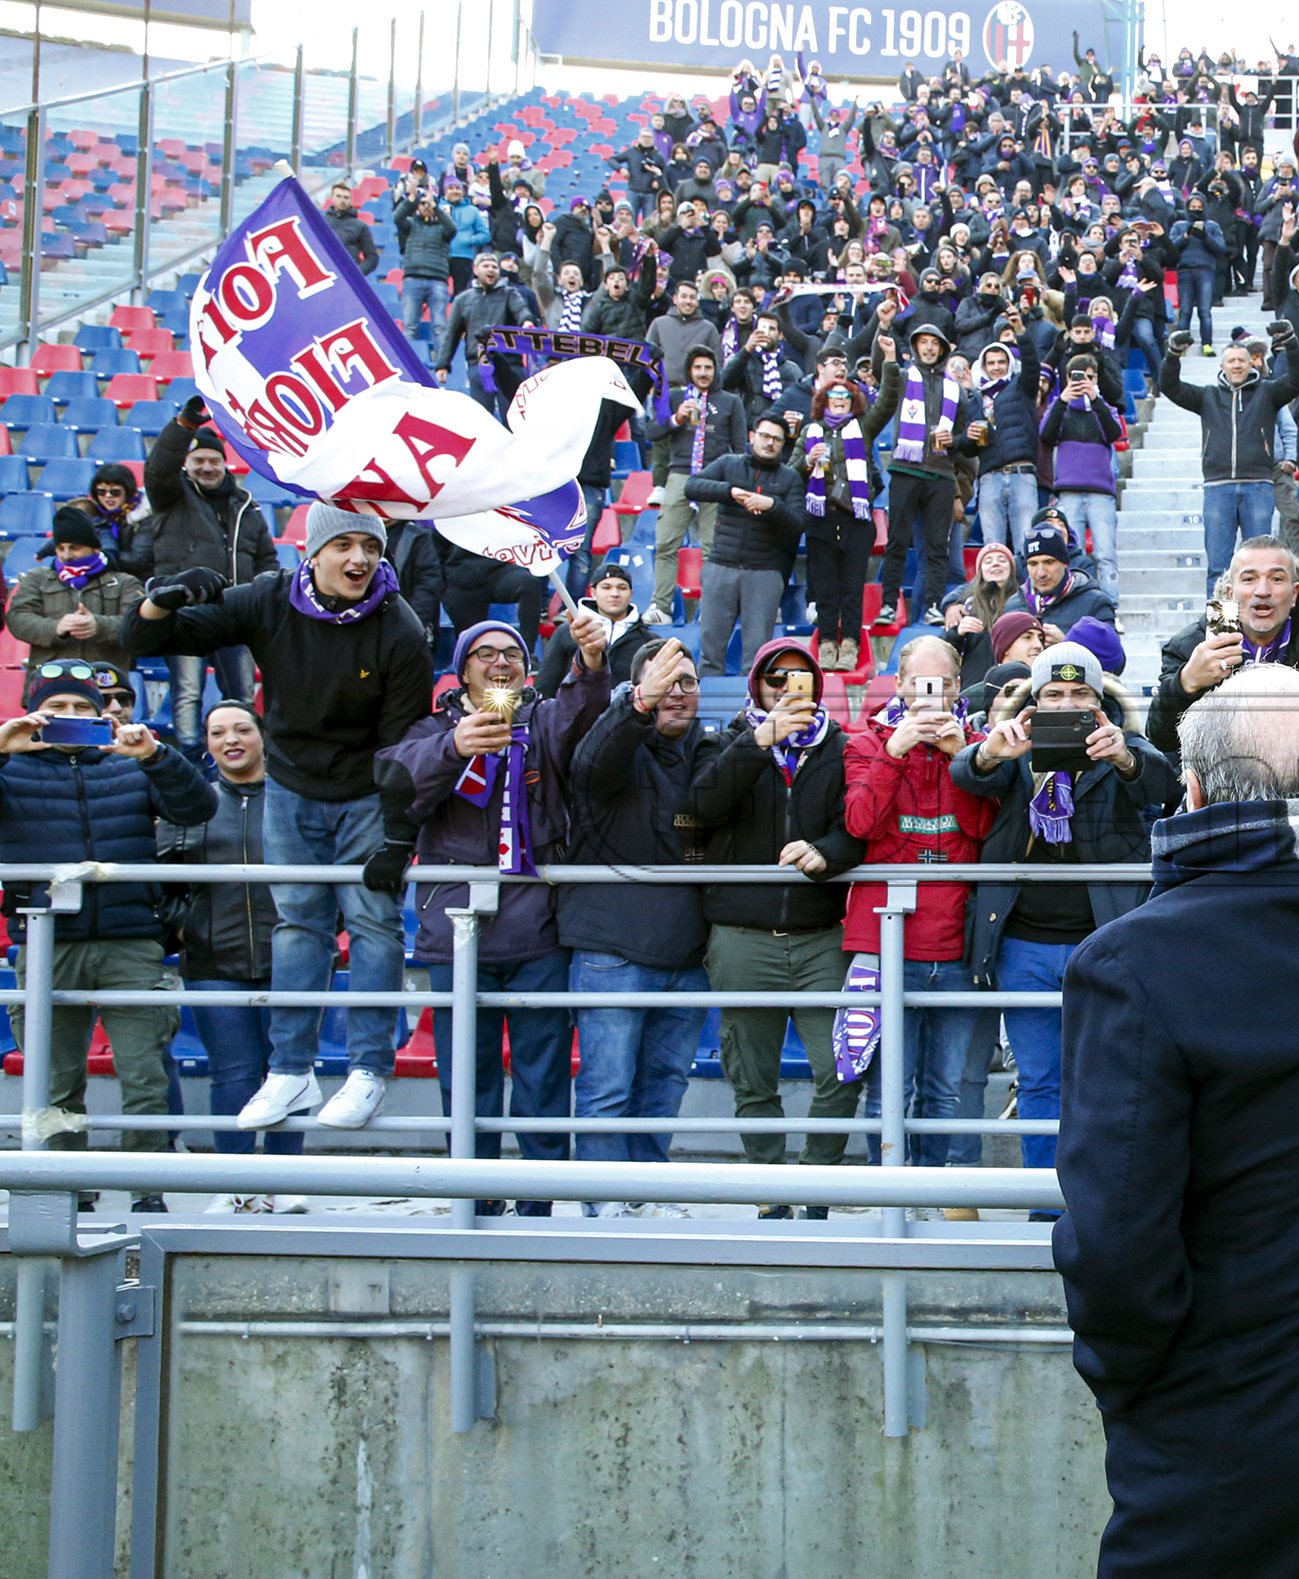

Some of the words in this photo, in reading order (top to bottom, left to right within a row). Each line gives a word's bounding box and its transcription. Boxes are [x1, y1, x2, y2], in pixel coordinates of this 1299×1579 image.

[649, 0, 818, 53] BOLOGNA
[828, 7, 871, 55] FC
[881, 10, 971, 58] 1909
